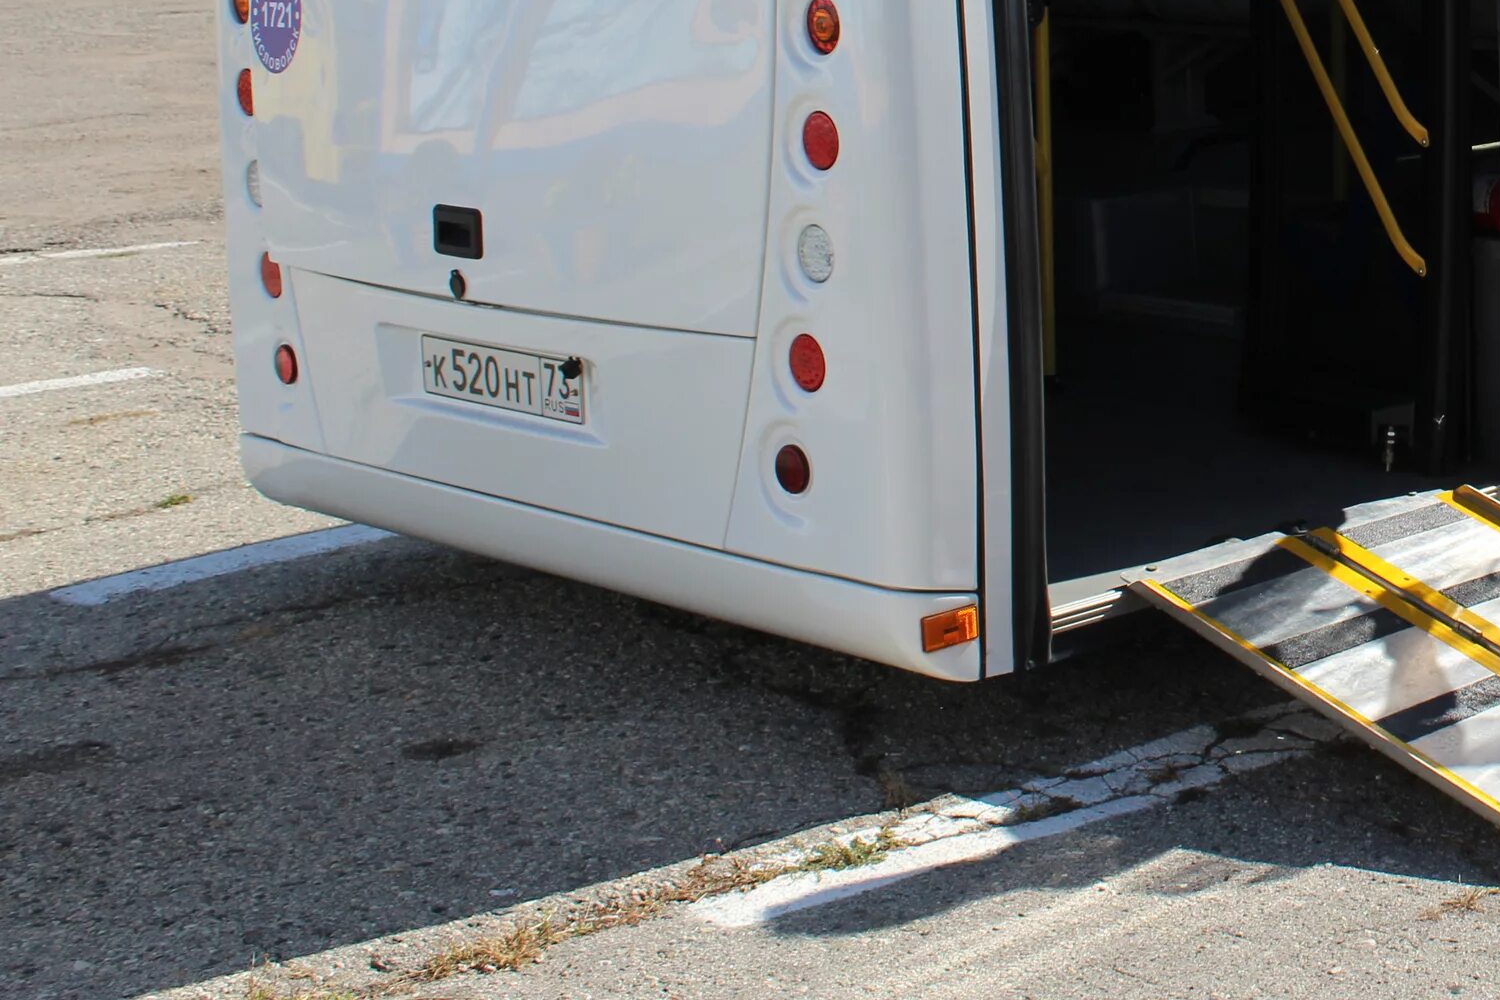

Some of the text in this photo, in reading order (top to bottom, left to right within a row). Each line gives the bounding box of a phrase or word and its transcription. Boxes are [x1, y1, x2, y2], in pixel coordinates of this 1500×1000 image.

[261, 1, 293, 29] 1721
[252, 22, 300, 72] КИСЛОВОДСК
[544, 398, 565, 415] RUS
